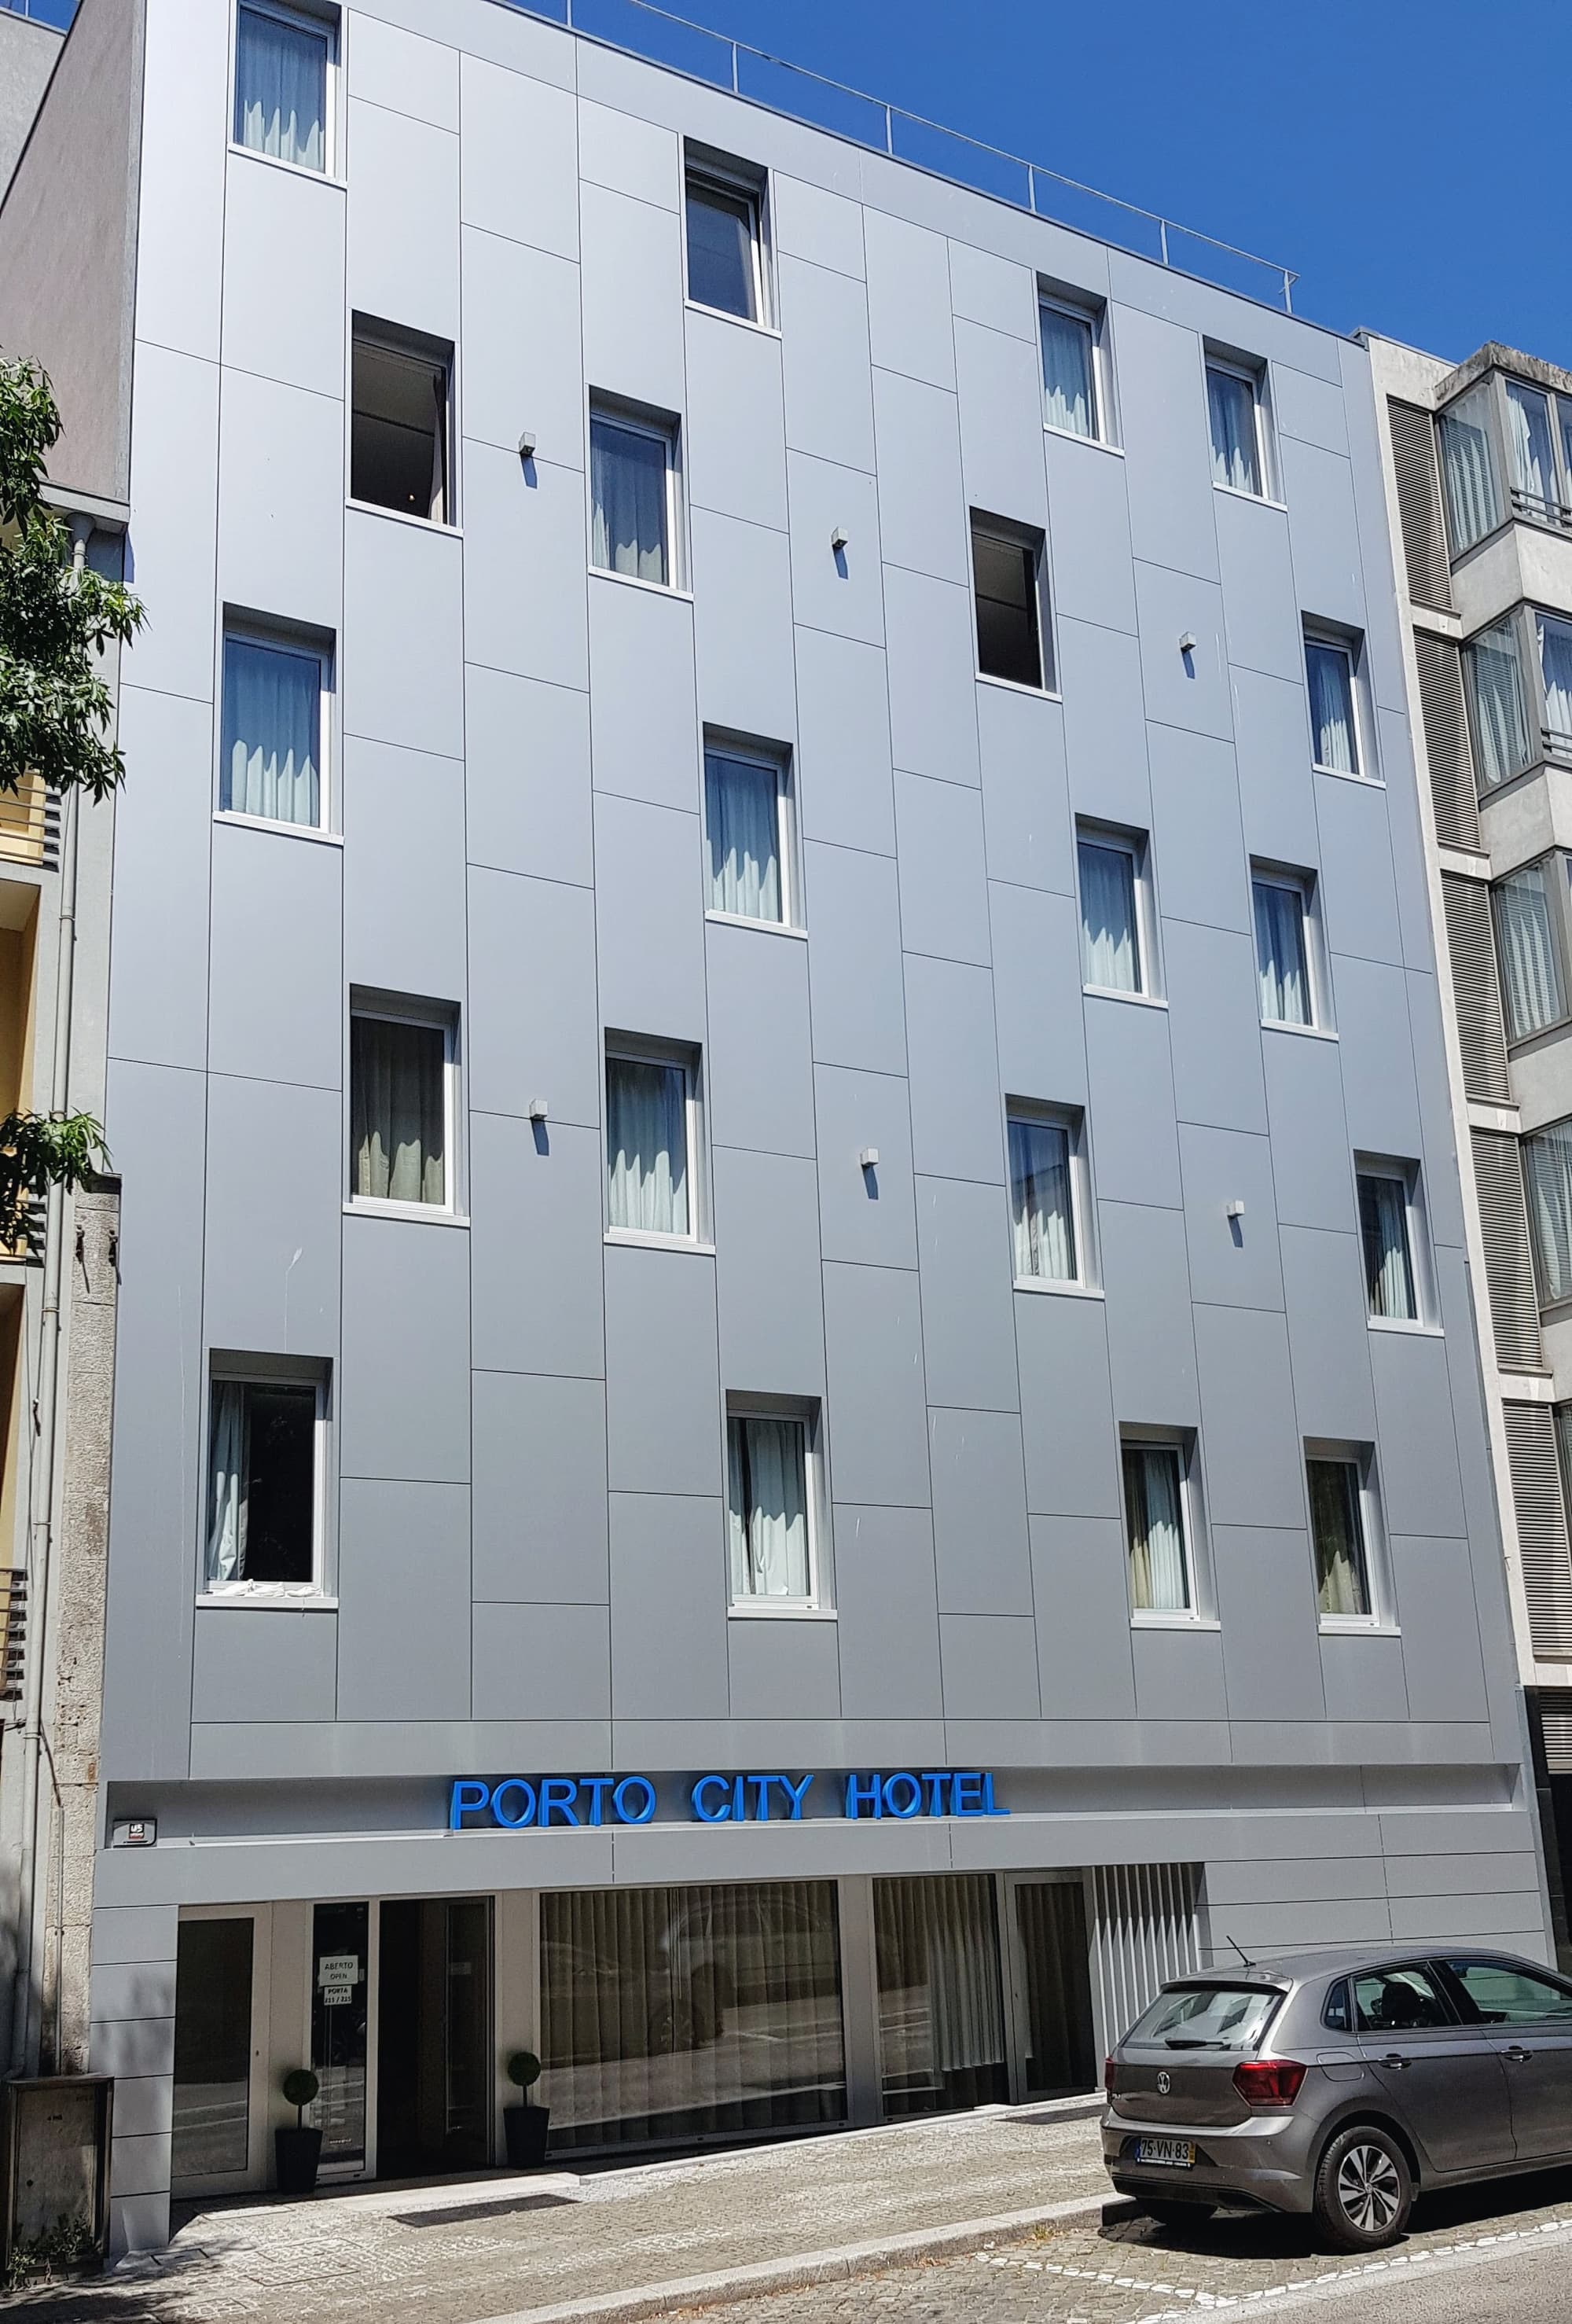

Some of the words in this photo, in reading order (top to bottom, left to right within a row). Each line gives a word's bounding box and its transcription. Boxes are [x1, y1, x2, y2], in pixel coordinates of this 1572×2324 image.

[450, 1776, 656, 1829] PORTO
[692, 1774, 815, 1822] CITY
[845, 1771, 1011, 1820] HOTEL
